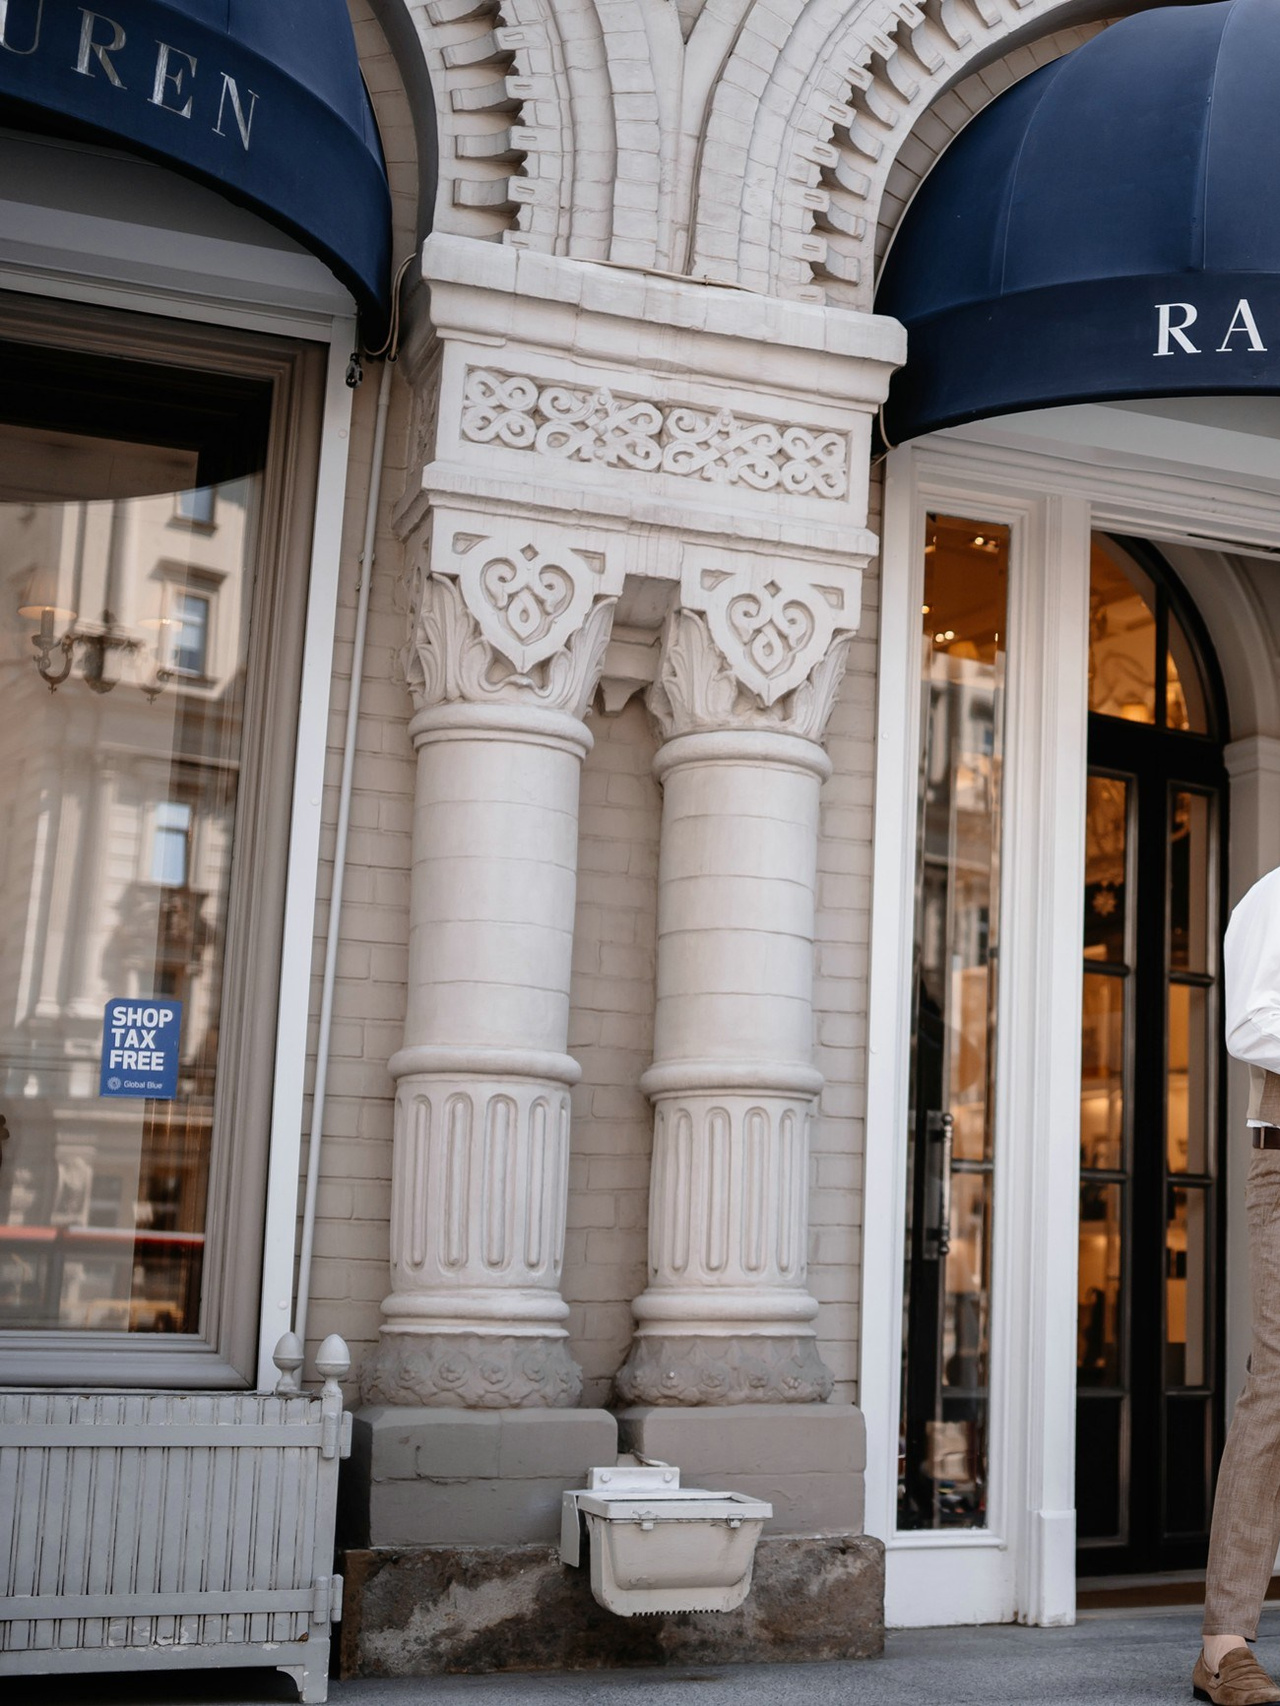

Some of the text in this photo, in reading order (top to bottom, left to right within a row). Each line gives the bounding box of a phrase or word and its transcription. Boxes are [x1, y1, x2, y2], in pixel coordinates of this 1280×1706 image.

[111, 1006, 174, 1029] SHOP
[111, 1028, 157, 1049] TAX
[109, 1049, 165, 1072] FREE
[123, 1080, 163, 1089] Global Blue
